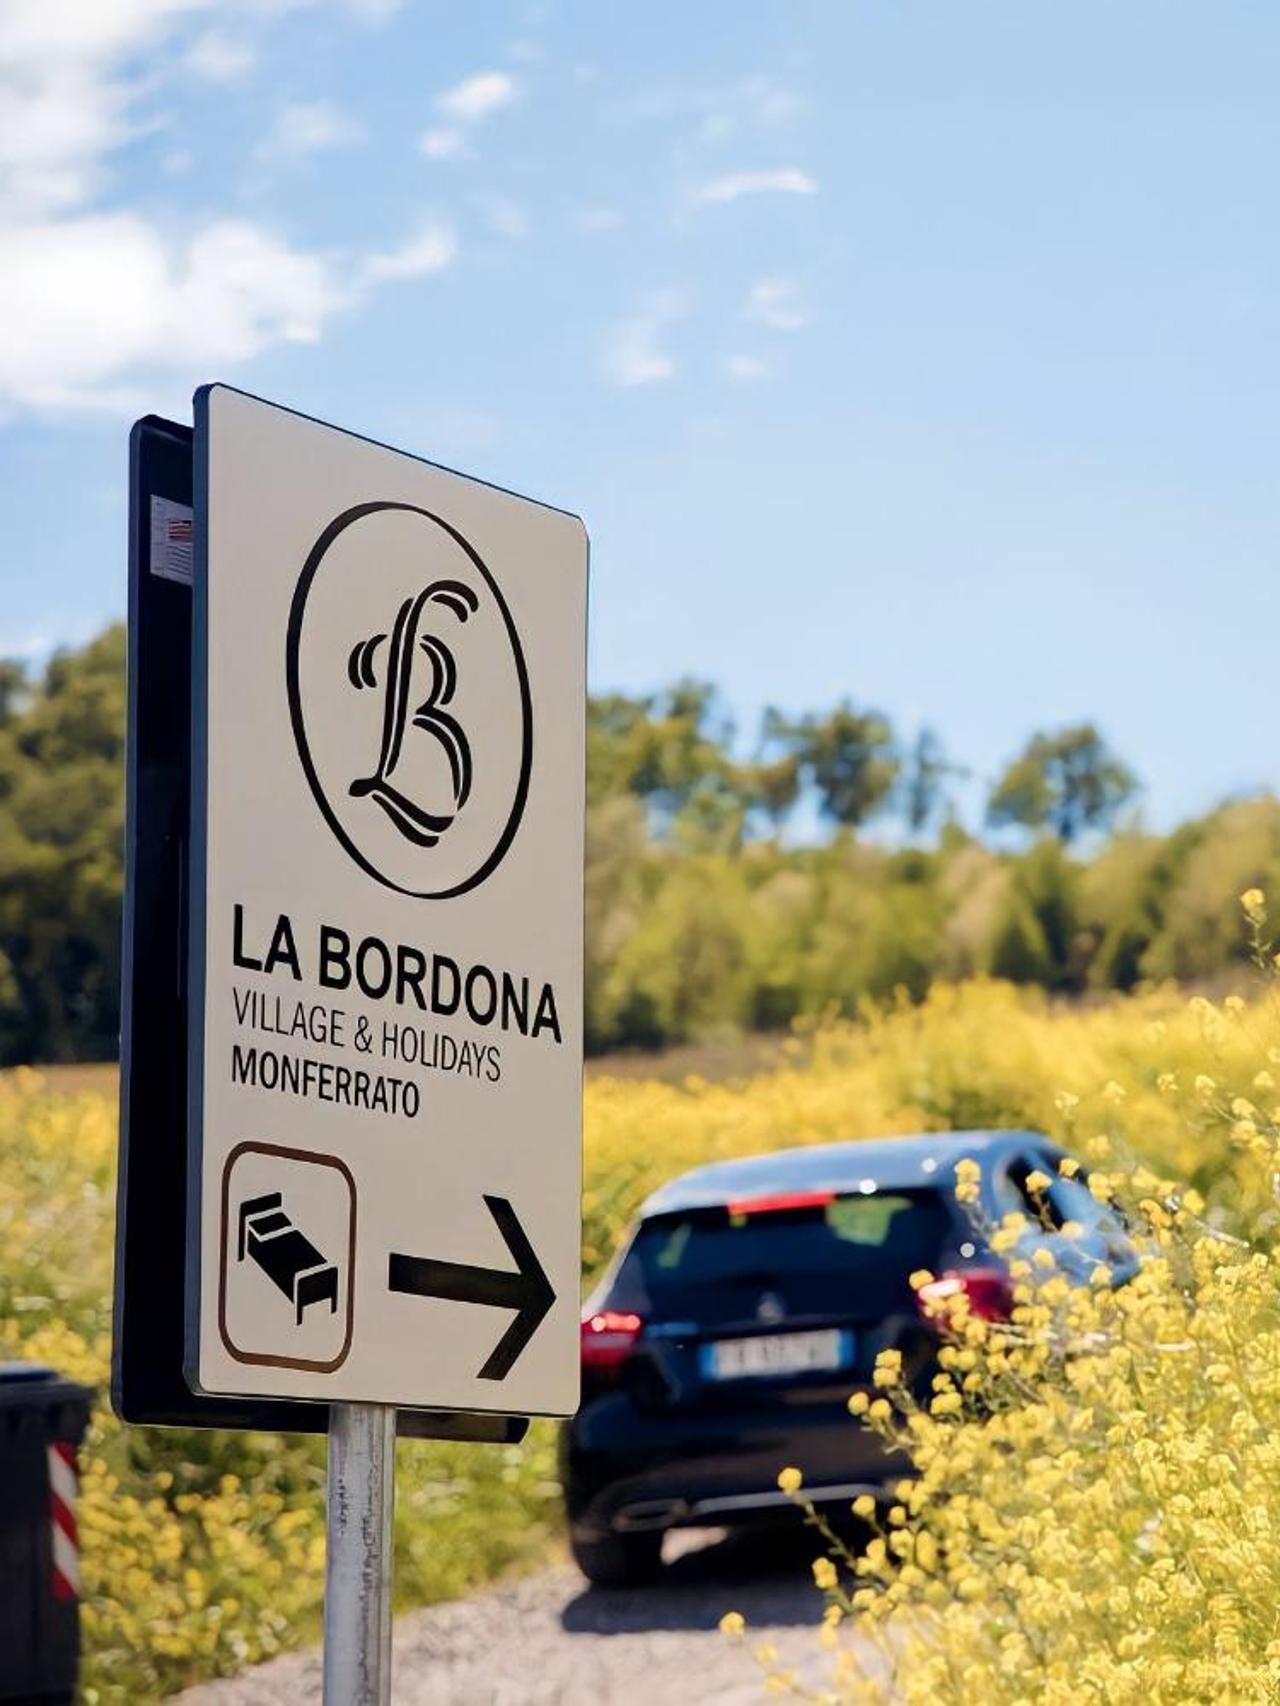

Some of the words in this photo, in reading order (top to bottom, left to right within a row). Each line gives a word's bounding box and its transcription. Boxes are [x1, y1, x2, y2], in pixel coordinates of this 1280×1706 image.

[232, 903, 303, 982] LA
[318, 924, 562, 1045] BORDONA
[231, 1044, 420, 1118] MONFERRATO
[232, 986, 346, 1047] VILLAGE
[353, 1015, 373, 1054] &
[381, 1020, 501, 1083] HOLIDAYS
